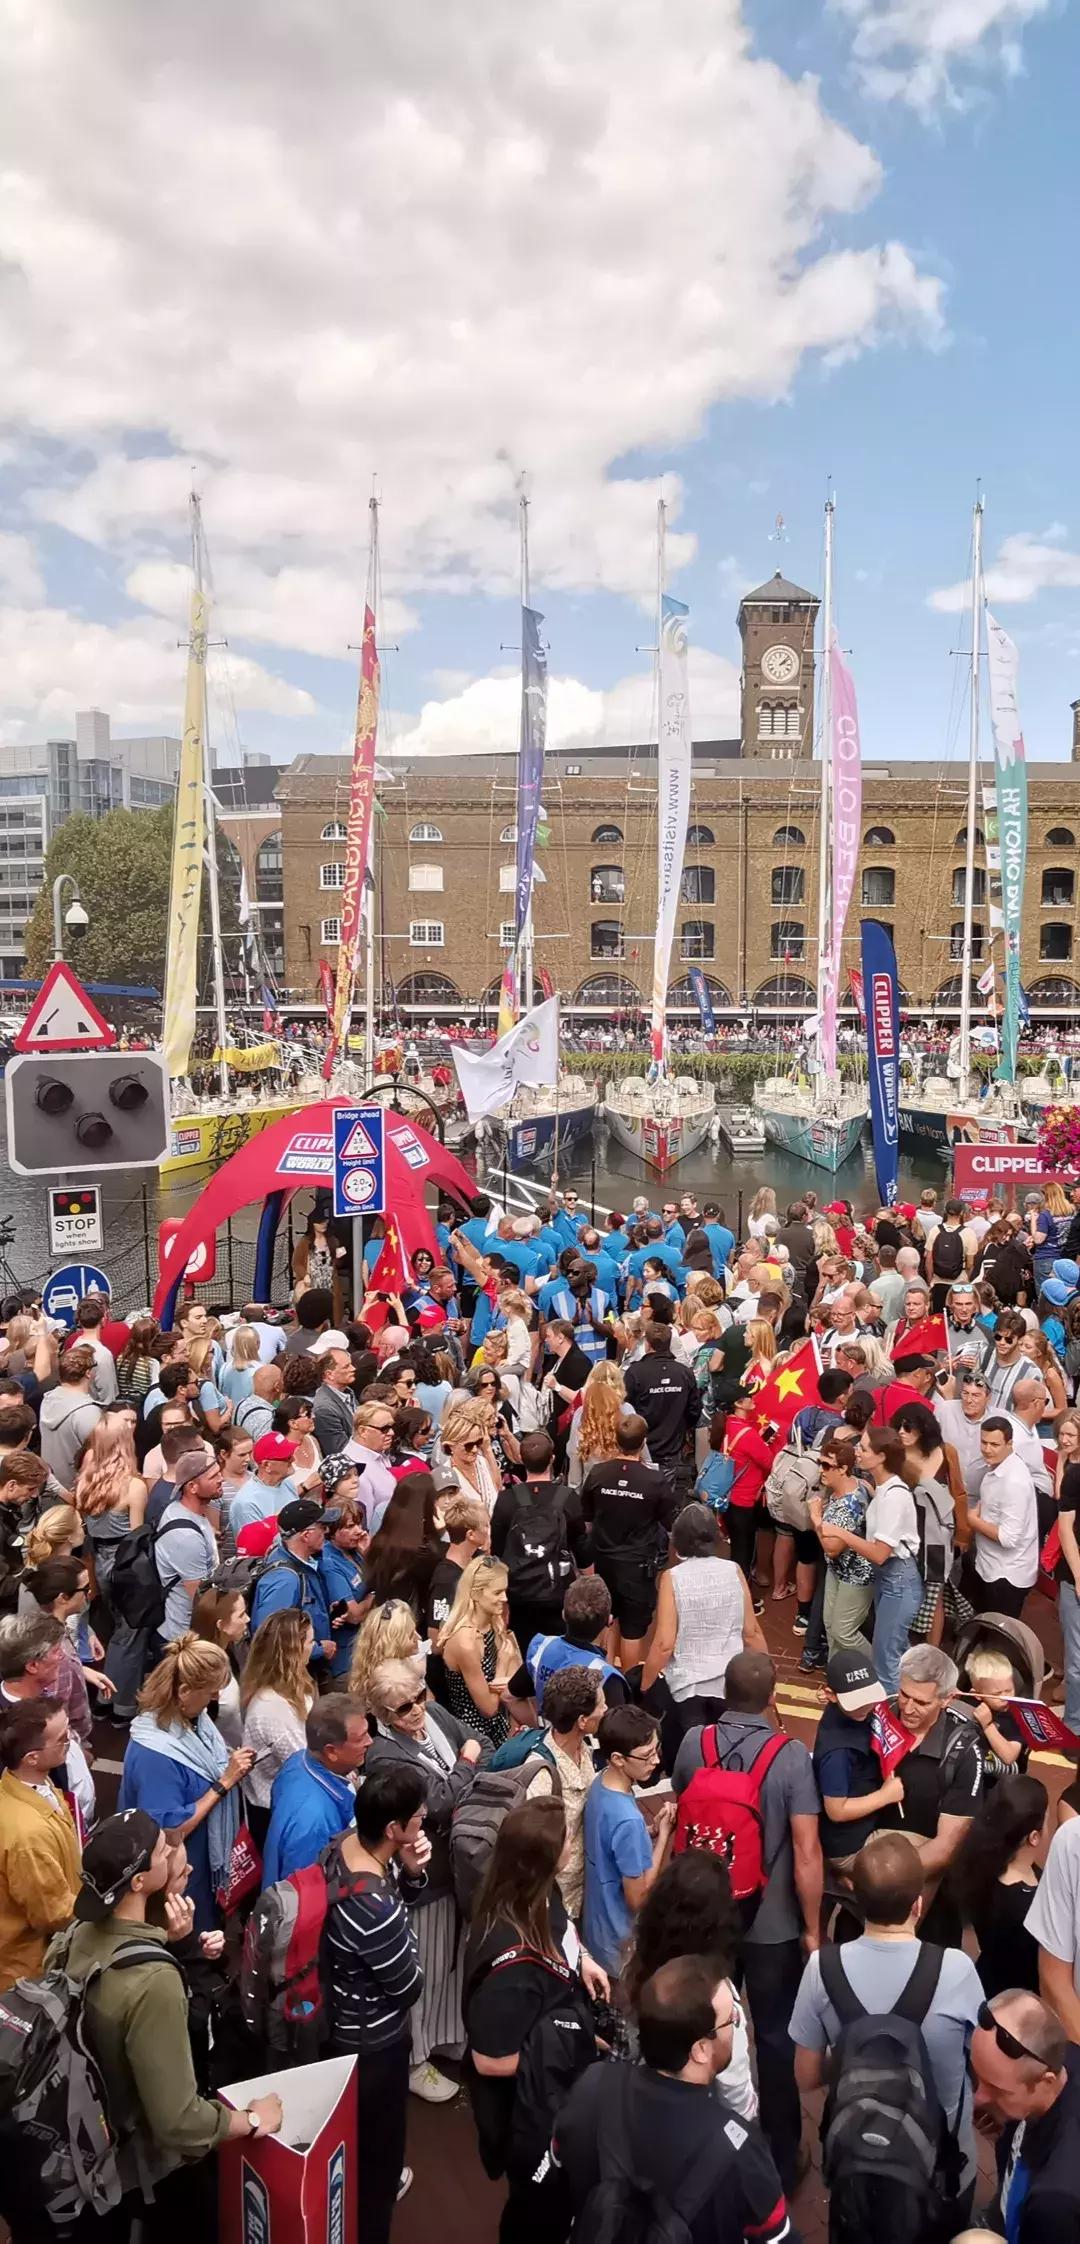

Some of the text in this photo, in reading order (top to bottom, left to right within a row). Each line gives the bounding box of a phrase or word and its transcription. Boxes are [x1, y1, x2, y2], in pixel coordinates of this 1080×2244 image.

[875, 981, 893, 1049] CLIPPER
[883, 1062, 894, 1117] WORLD
[337, 1112, 358, 1120] Bridge
[295, 1137, 333, 1150] CLIPP
[55, 1218, 96, 1232] STOP
[55, 1240, 76, 1248] lights
[601, 1487, 644, 1500] RACE OFFICIAL
[970, 1761, 982, 1797] HANSEN
[233, 1840, 257, 1875] LIFE
[491, 1950, 517, 1967] Canon
